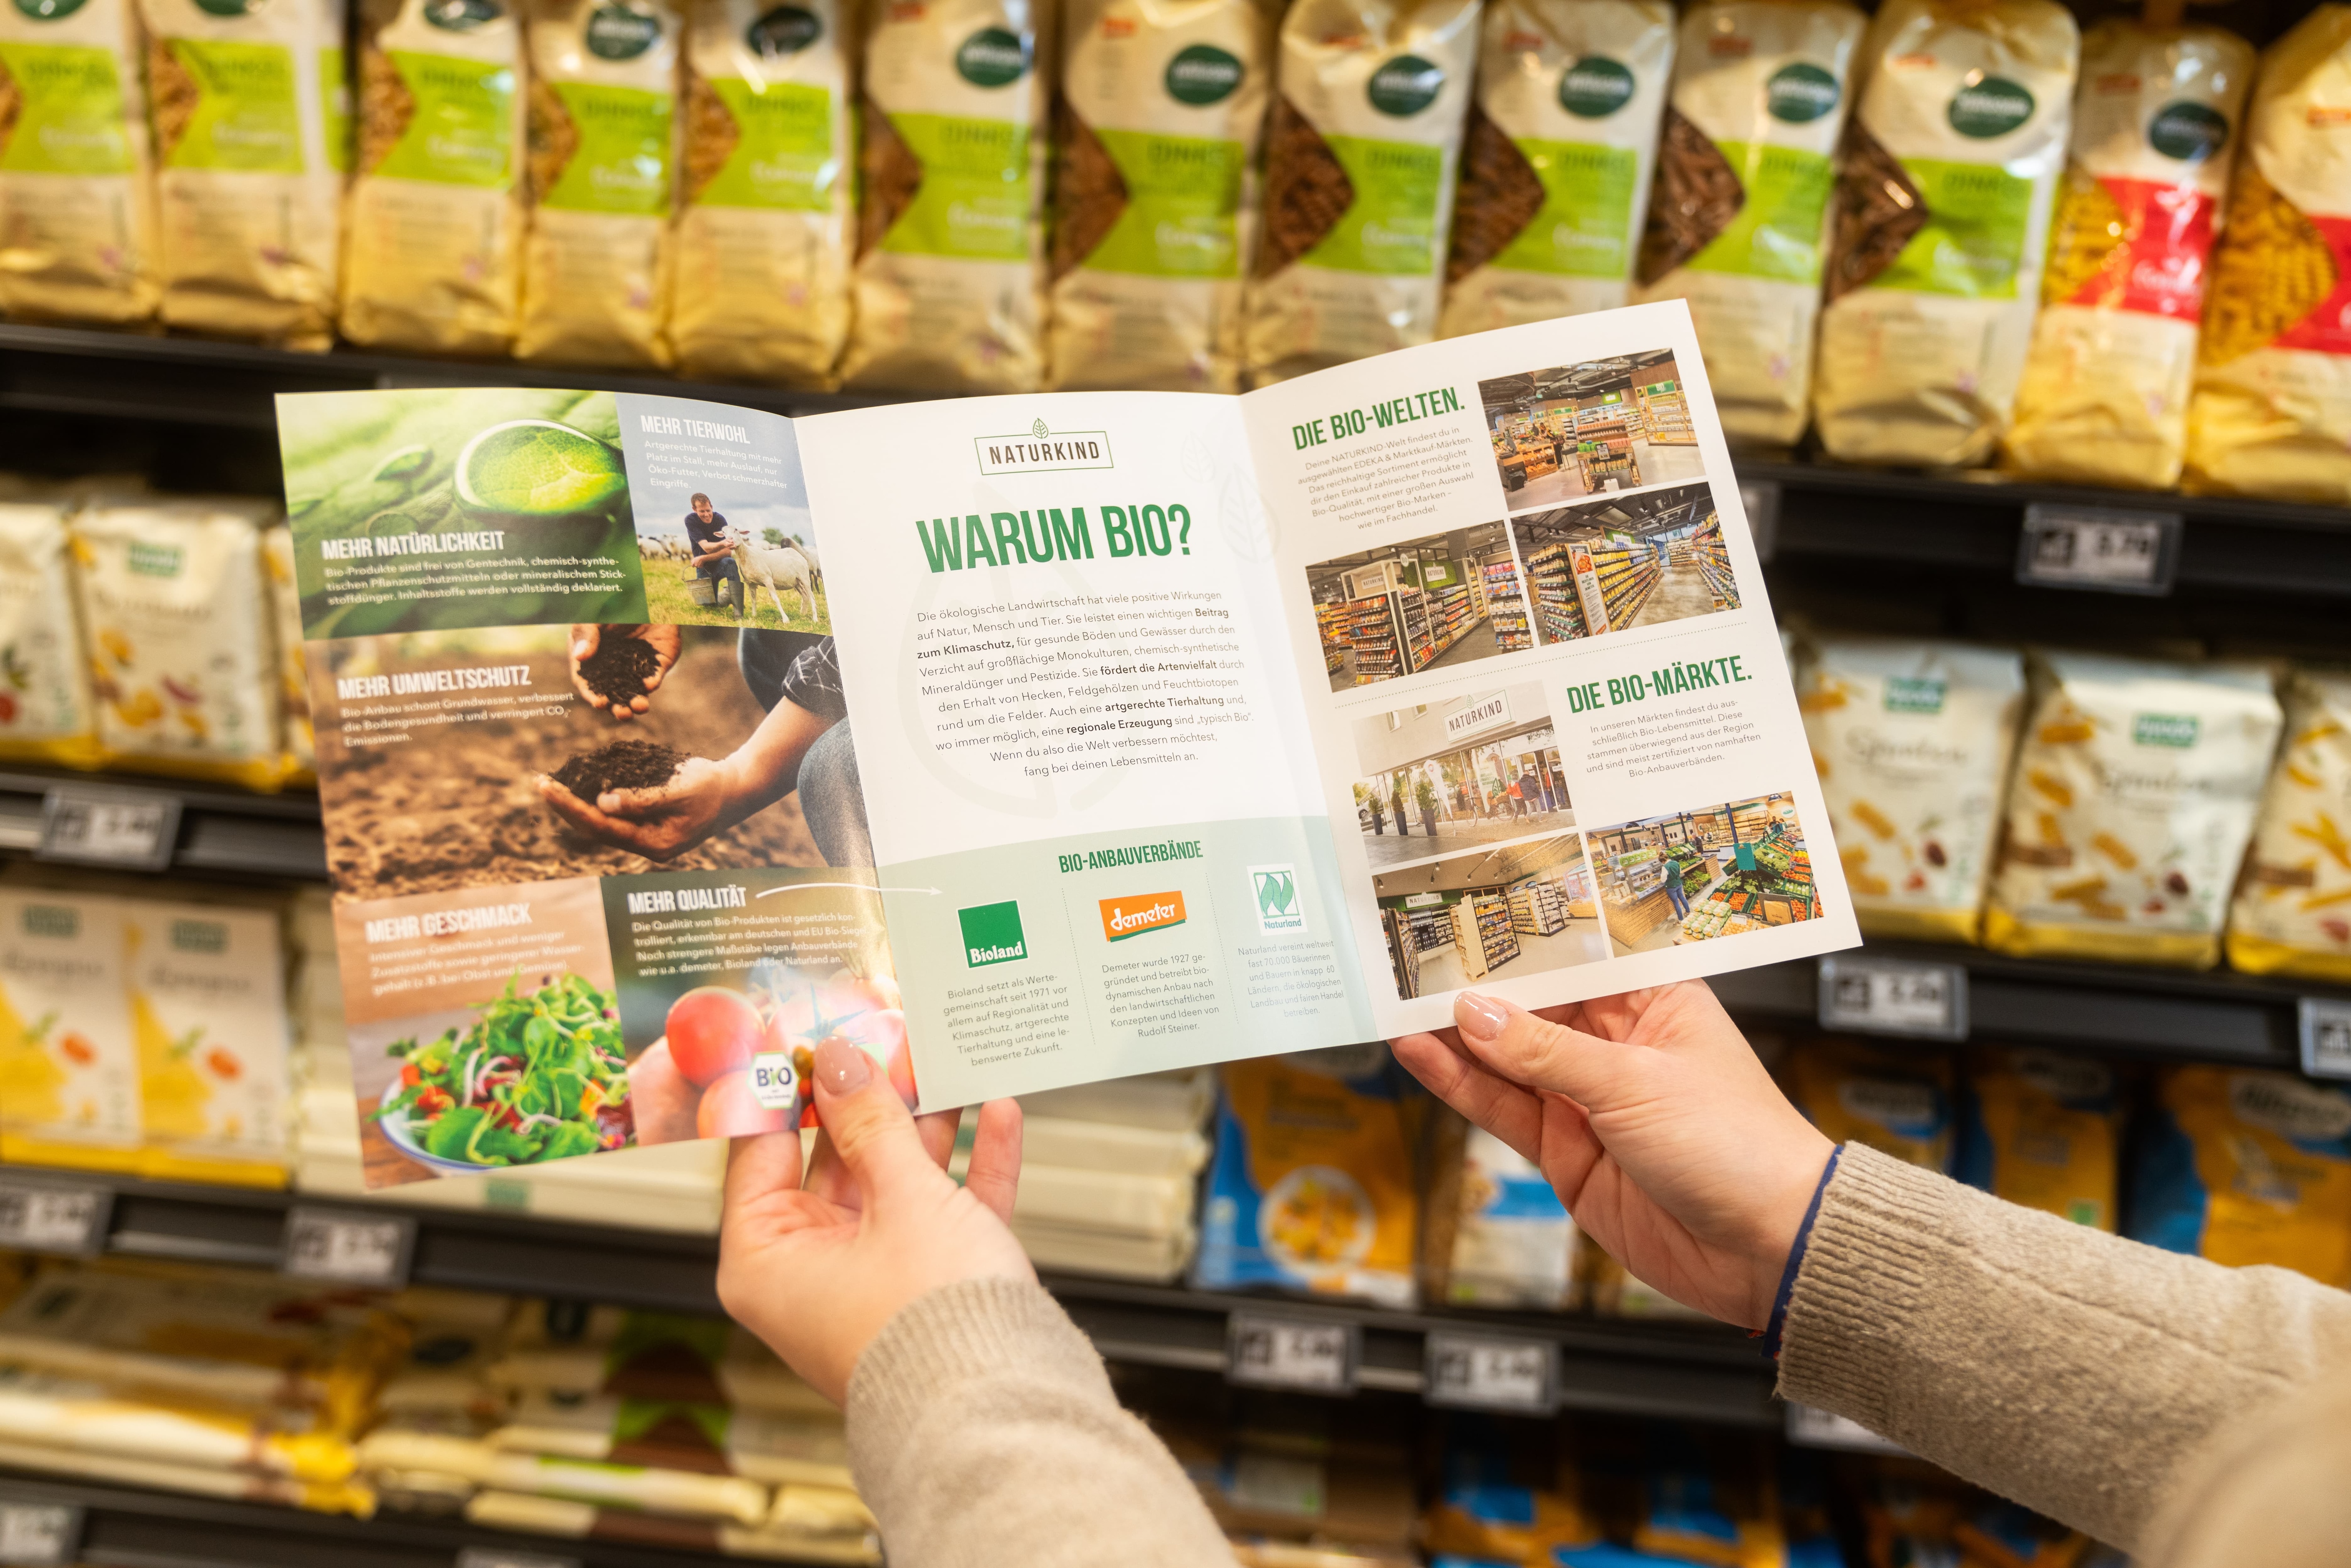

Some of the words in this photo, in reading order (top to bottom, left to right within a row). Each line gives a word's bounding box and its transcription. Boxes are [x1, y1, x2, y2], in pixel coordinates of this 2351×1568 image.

[640, 415, 682, 435] MEHR
[683, 419, 750, 444] TIERWOHL
[1292, 419, 1327, 450] DIE
[1330, 386, 1465, 440] BIO-WELTEN.
[645, 440, 698, 452] Artgerechte
[699, 445, 747, 460] Tierhaltung
[763, 453, 782, 465] mehr
[647, 453, 668, 463] Platz
[670, 454, 681, 463] im
[707, 458, 729, 468] mehr
[765, 467, 778, 476] nur
[989, 441, 1100, 464] NATURKIND
[1308, 485, 1325, 494] Das
[1326, 472, 1375, 489] reichhaltige
[1377, 460, 1419, 476] Sortiment
[1420, 449, 1467, 465] ermöglicht
[1310, 497, 1322, 505] dir
[1323, 493, 1340, 502] den
[1341, 482, 1372, 497] Einkauf
[1374, 473, 1420, 489] zahlreicher
[1421, 464, 1460, 477] Produkte
[1357, 521, 1372, 530] wie
[1386, 504, 1438, 523] Fachhandel.
[321, 537, 373, 560] MEHR
[375, 531, 505, 557] NATÜRLICHKEIT
[915, 507, 1094, 573] WARUM
[1100, 504, 1191, 558] BIO?
[324, 564, 397, 578] Bio-Produkte
[398, 562, 422, 573] sind
[423, 560, 442, 571] frei
[445, 561, 464, 569] von
[917, 612, 936, 622] Die
[939, 603, 1005, 619] ökologische
[1007, 595, 1086, 611] Landwirtschaft
[1087, 595, 1104, 605] hat
[1105, 593, 1129, 603] viele
[1131, 592, 1169, 605] positive
[1170, 591, 1222, 602] Wirkungen
[917, 629, 934, 641] auf
[937, 628, 970, 638] Natur,
[972, 620, 1015, 633] Mensch
[1018, 617, 1039, 628] und
[1040, 616, 1064, 626] Tier.
[1065, 615, 1081, 624] Sie
[1084, 613, 1115, 622] leistet
[1117, 611, 1145, 621] einen
[1146, 609, 1193, 620] wichtigen
[1194, 608, 1229, 619] Beitrag
[916, 649, 941, 659] zum
[943, 640, 1014, 655] Klimaschutz,
[1016, 637, 1031, 646] für
[1034, 632, 1080, 647] gesunde
[1082, 630, 1116, 641] Böden
[1119, 628, 1138, 638] und
[1140, 627, 1187, 637] Gewässer
[1189, 625, 1216, 635] durch
[1218, 625, 1235, 634] den
[336, 675, 391, 700] MEHR
[391, 665, 532, 695] UMWELTSCHUTZ
[922, 678, 1003, 696] Mineraldünger
[1007, 673, 1028, 685] und
[1030, 669, 1080, 682] Pestizide.
[1082, 667, 1098, 677] Sie
[1100, 664, 1137, 676] fördert
[1139, 663, 1155, 673] die
[1158, 660, 1217, 671] Artenvielfalt
[1219, 659, 1245, 669] durch
[1567, 682, 1605, 713] DIE
[1607, 655, 1752, 705] BIO-MÄRKTE.
[402, 701, 441, 712] schont
[518, 693, 574, 703] verbessert
[1449, 700, 1502, 732] NATURKIND
[1601, 719, 1636, 731] unseren
[1637, 712, 1674, 724] Märkten
[1675, 705, 1705, 717] findest
[1707, 702, 1719, 711] du
[935, 742, 952, 751] wo
[955, 736, 990, 748] immer
[993, 728, 1039, 743] möglich,
[1041, 727, 1064, 736] eine
[1066, 720, 1116, 735] regionale
[1118, 718, 1173, 729] Erzeugung
[1175, 714, 1194, 725] sind
[1587, 747, 1628, 760] stammen
[1629, 733, 1688, 751] überwiegend
[1706, 728, 1721, 737] der
[1723, 723, 1754, 733] Region
[1024, 766, 1049, 777] fang
[1051, 762, 1069, 773] bei
[1072, 760, 1108, 771] deinen
[1110, 752, 1182, 767] Lebensmitteln
[1628, 754, 1725, 778] Bio-Anbauverbänden.
[1058, 841, 1203, 873] BIO-ANBAUVERBÄNDE
[627, 890, 676, 914] MEHR
[676, 884, 746, 911] QUALITÄT
[365, 915, 420, 944] MEHR
[421, 903, 533, 937] GESCHMACK
[631, 922, 651, 933] Die
[651, 919, 693, 931] Qualität
[694, 919, 713, 928] von
[713, 915, 780, 926] Bio-Produkten
[781, 914, 792, 923] ist
[795, 913, 836, 925] gesetzlich
[1110, 903, 1175, 931] demeter
[1264, 919, 1302, 930] Naturland
[970, 941, 1024, 964] Bioland
[1238, 944, 1277, 956] Naturland
[1278, 942, 1304, 951] vereint
[1305, 940, 1334, 949] weltweit
[1248, 959, 1263, 968] fast
[1264, 955, 1290, 966] 70.000
[1291, 953, 1331, 963] Bäuerinnen
[1102, 962, 1140, 973] Demeter
[1142, 957, 1168, 968] wurde
[1170, 953, 1189, 964] 1927
[1191, 954, 1206, 964] ge-
[1104, 975, 1139, 989] gründet
[1141, 971, 1157, 982] und
[1159, 968, 1192, 979] betreibt
[1193, 966, 1209, 975] bio-
[943, 994, 1008, 1017] gemeinschaft
[1010, 992, 1027, 1002] seit
[1029, 987, 1049, 998] 1971
[947, 984, 984, 1000] Bioland
[986, 981, 1010, 992] setzt
[1011, 978, 1024, 987] als
[1025, 975, 1057, 985] Werte-
